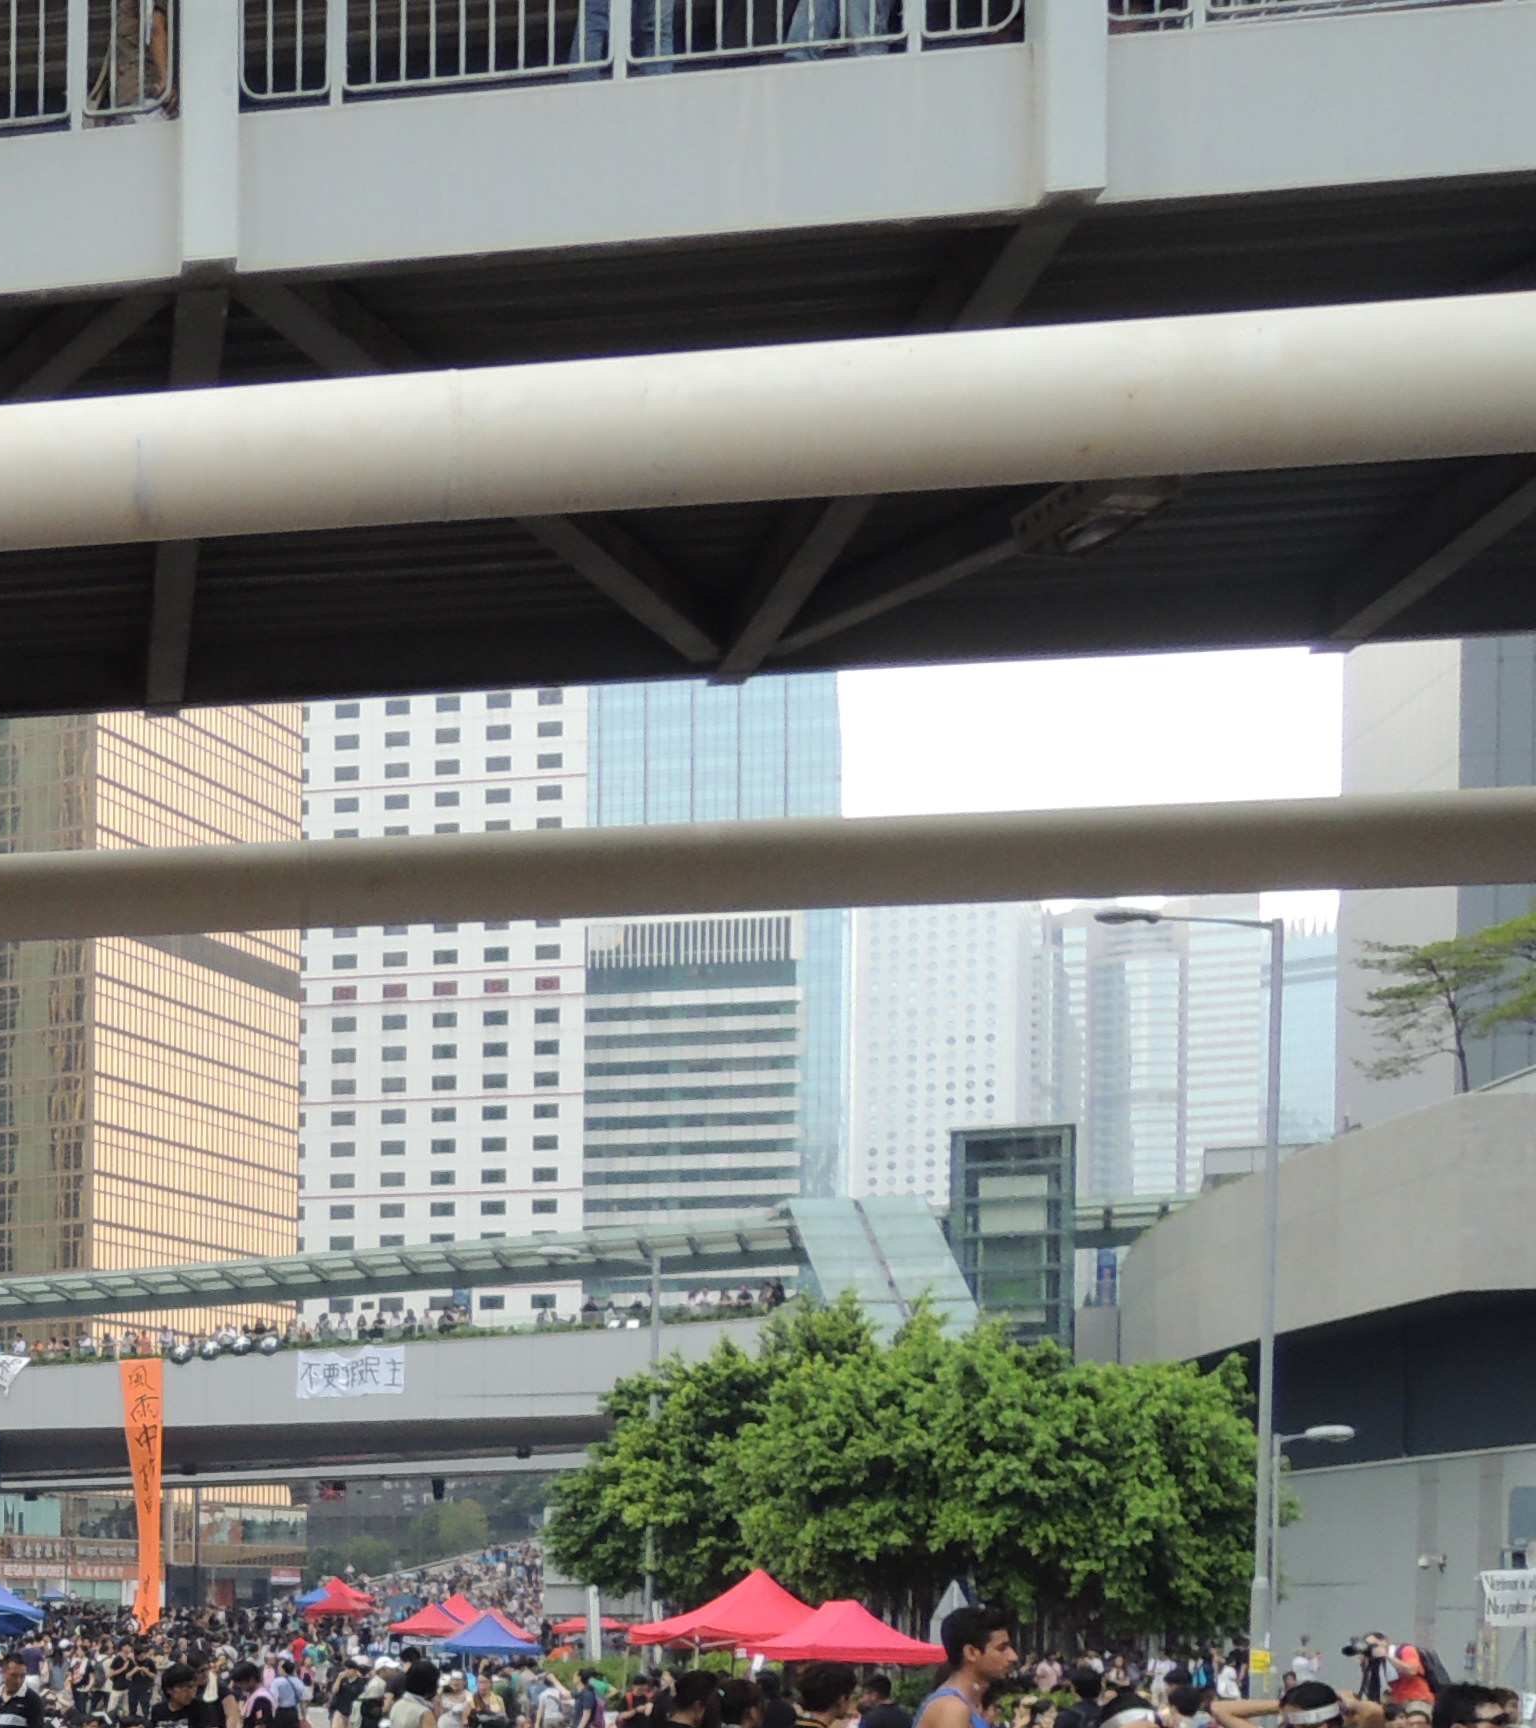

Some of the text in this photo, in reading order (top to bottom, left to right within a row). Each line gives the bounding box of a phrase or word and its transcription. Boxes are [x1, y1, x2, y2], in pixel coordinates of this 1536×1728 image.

[301, 1356, 404, 1390] 不要假民主
